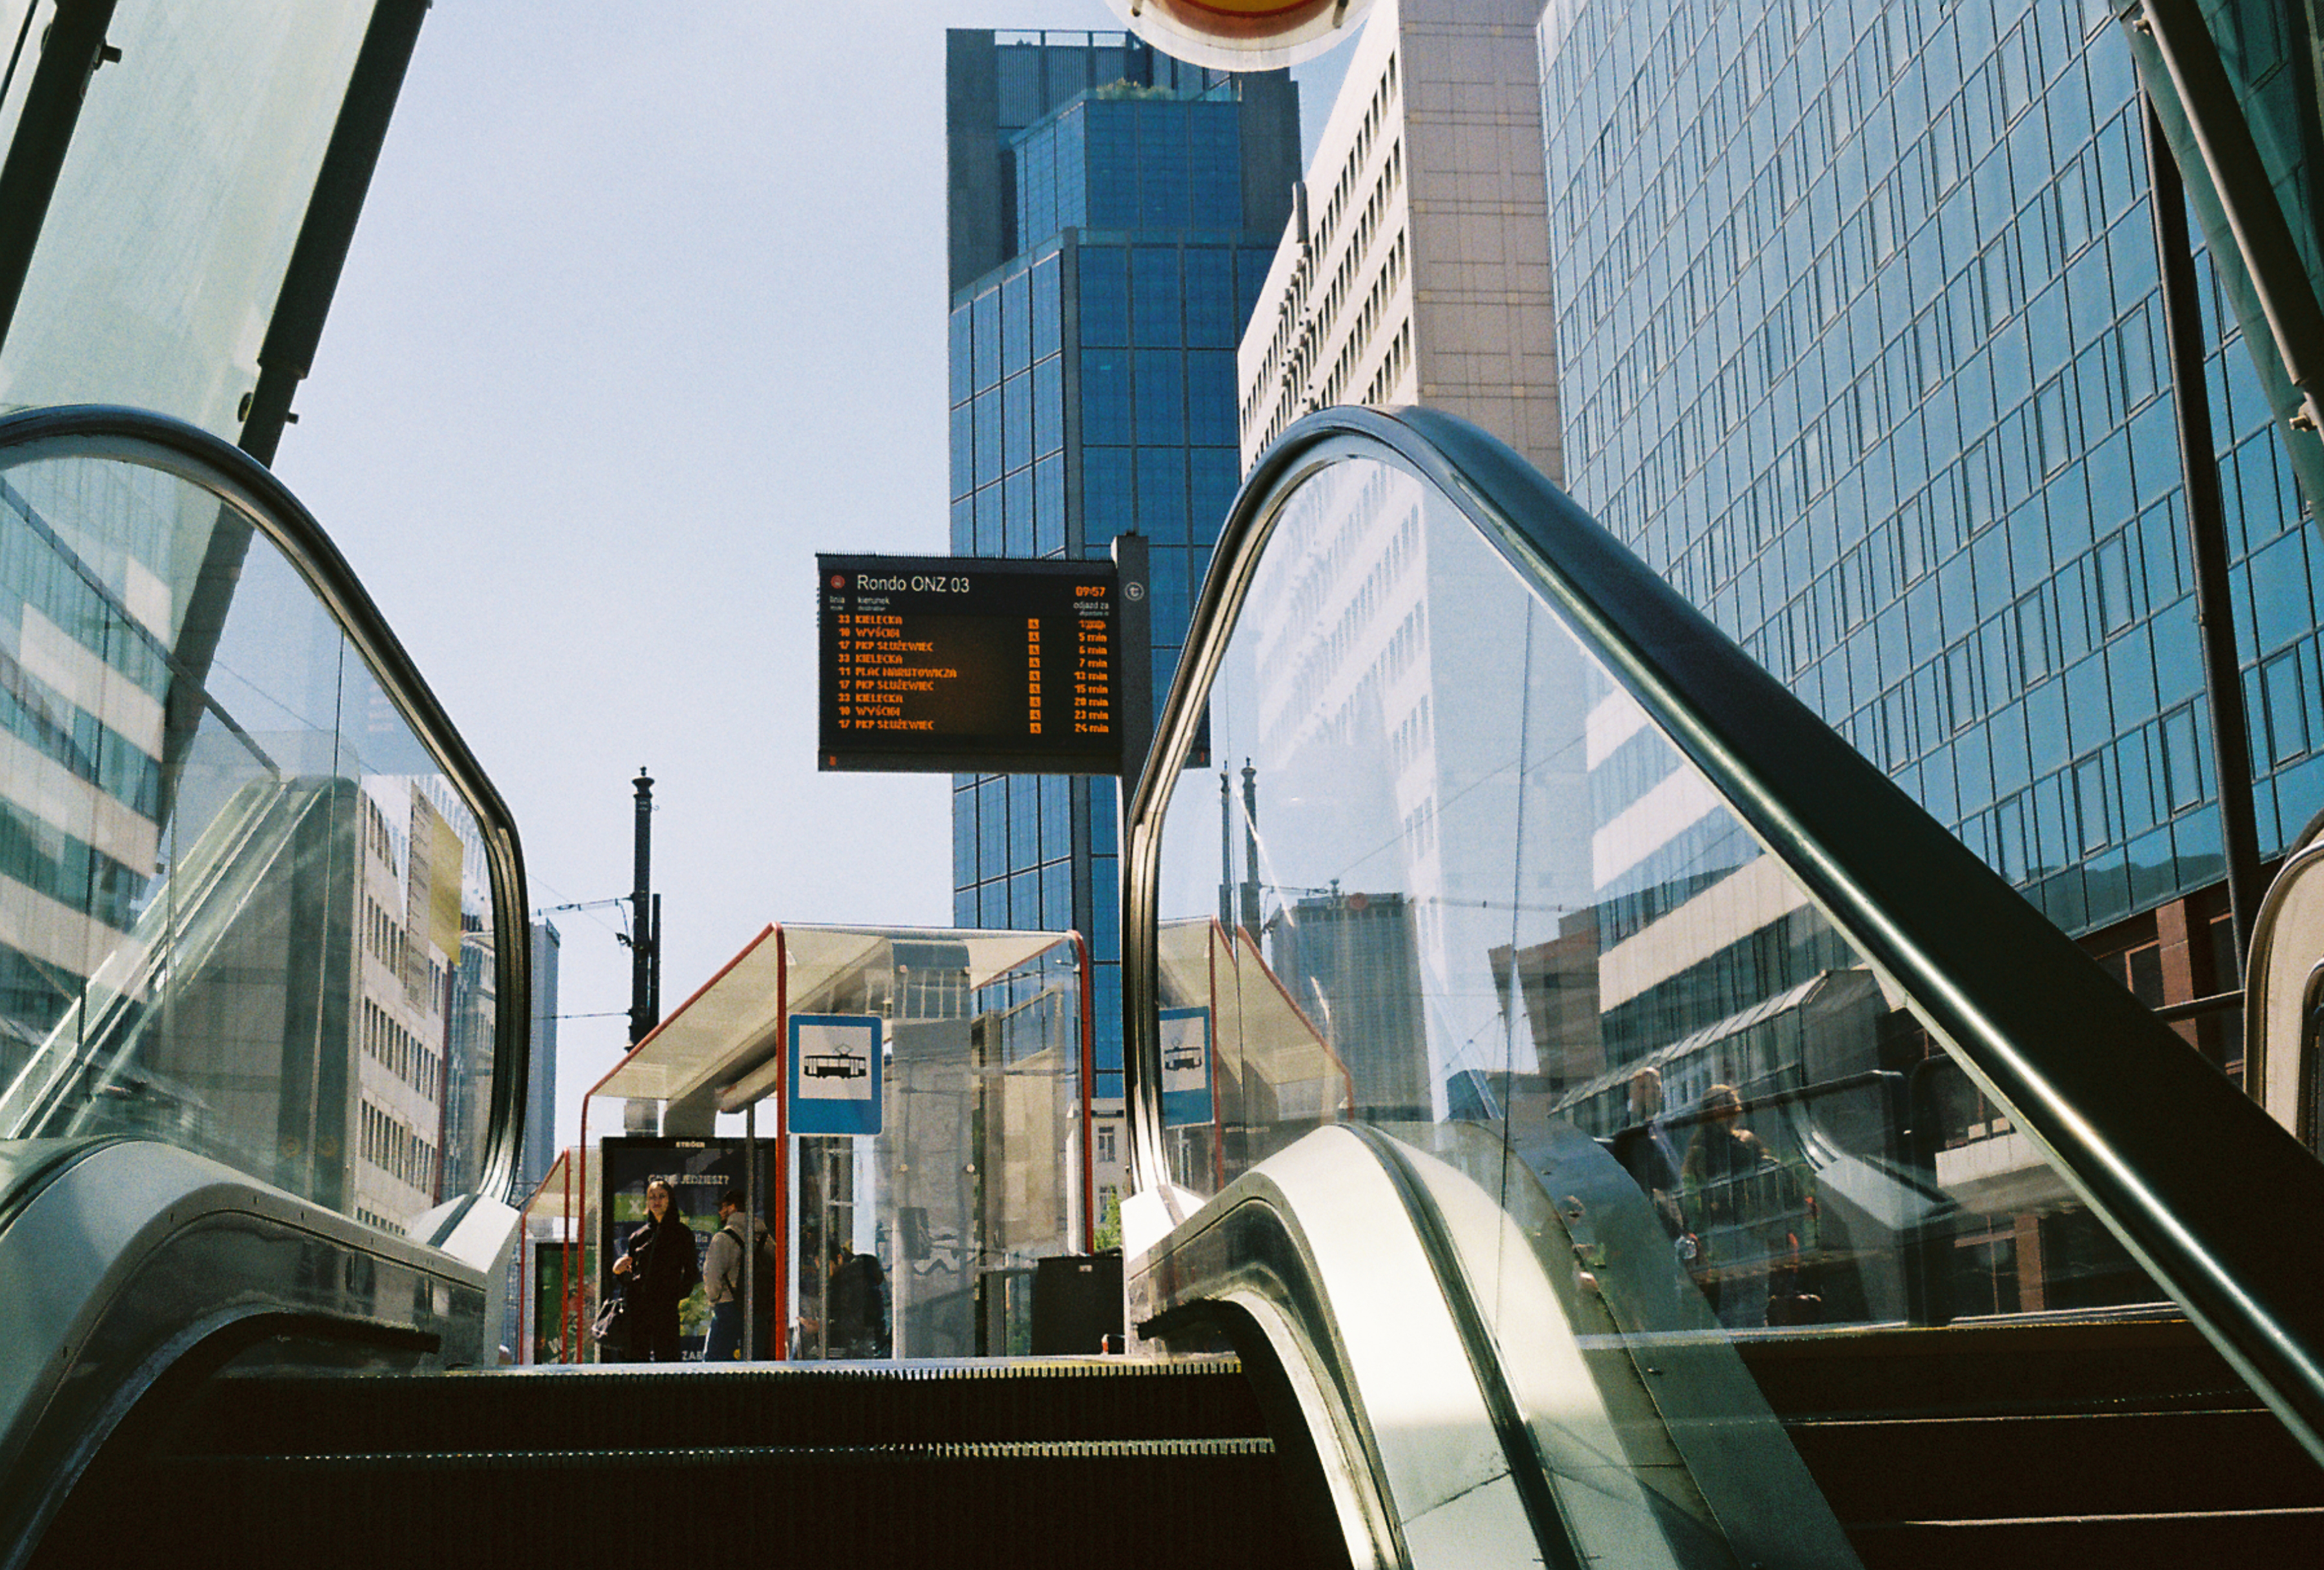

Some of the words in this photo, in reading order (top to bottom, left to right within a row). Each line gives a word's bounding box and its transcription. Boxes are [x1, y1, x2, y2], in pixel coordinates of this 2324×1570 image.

[857, 574, 907, 591] Rondo
[911, 576, 947, 592] ONZ
[951, 578, 970, 593] 03
[1075, 586, 1106, 597] 09:57
[838, 614, 850, 623] 33
[855, 614, 903, 625] KIELECKA
[1078, 632, 1086, 642] 5
[1087, 632, 1107, 642] min
[838, 640, 851, 650] 17
[855, 641, 874, 650] PKP
[1087, 646, 1107, 655] min
[838, 654, 850, 663] 33
[855, 654, 903, 664] KIELECKA
[1079, 658, 1086, 668] 7
[1087, 658, 1107, 668] min
[838, 667, 851, 676] 11
[855, 667, 880, 677] PLAC
[1074, 670, 1086, 680] 13
[1088, 671, 1108, 681] min
[838, 679, 851, 689] 17
[855, 679, 874, 690] PKP
[1074, 683, 1086, 694] 15
[1088, 684, 1109, 694] min
[838, 692, 851, 702] 33
[855, 693, 904, 703] KIELECKA
[1088, 697, 1109, 707] min
[1075, 710, 1087, 720] 23
[1088, 710, 1109, 720] min
[838, 719, 851, 729] 17
[855, 720, 874, 729] PKP
[1075, 723, 1088, 732] 24
[1089, 723, 1109, 733] min
[681, 1174, 729, 1185] JEDZIESZ?
